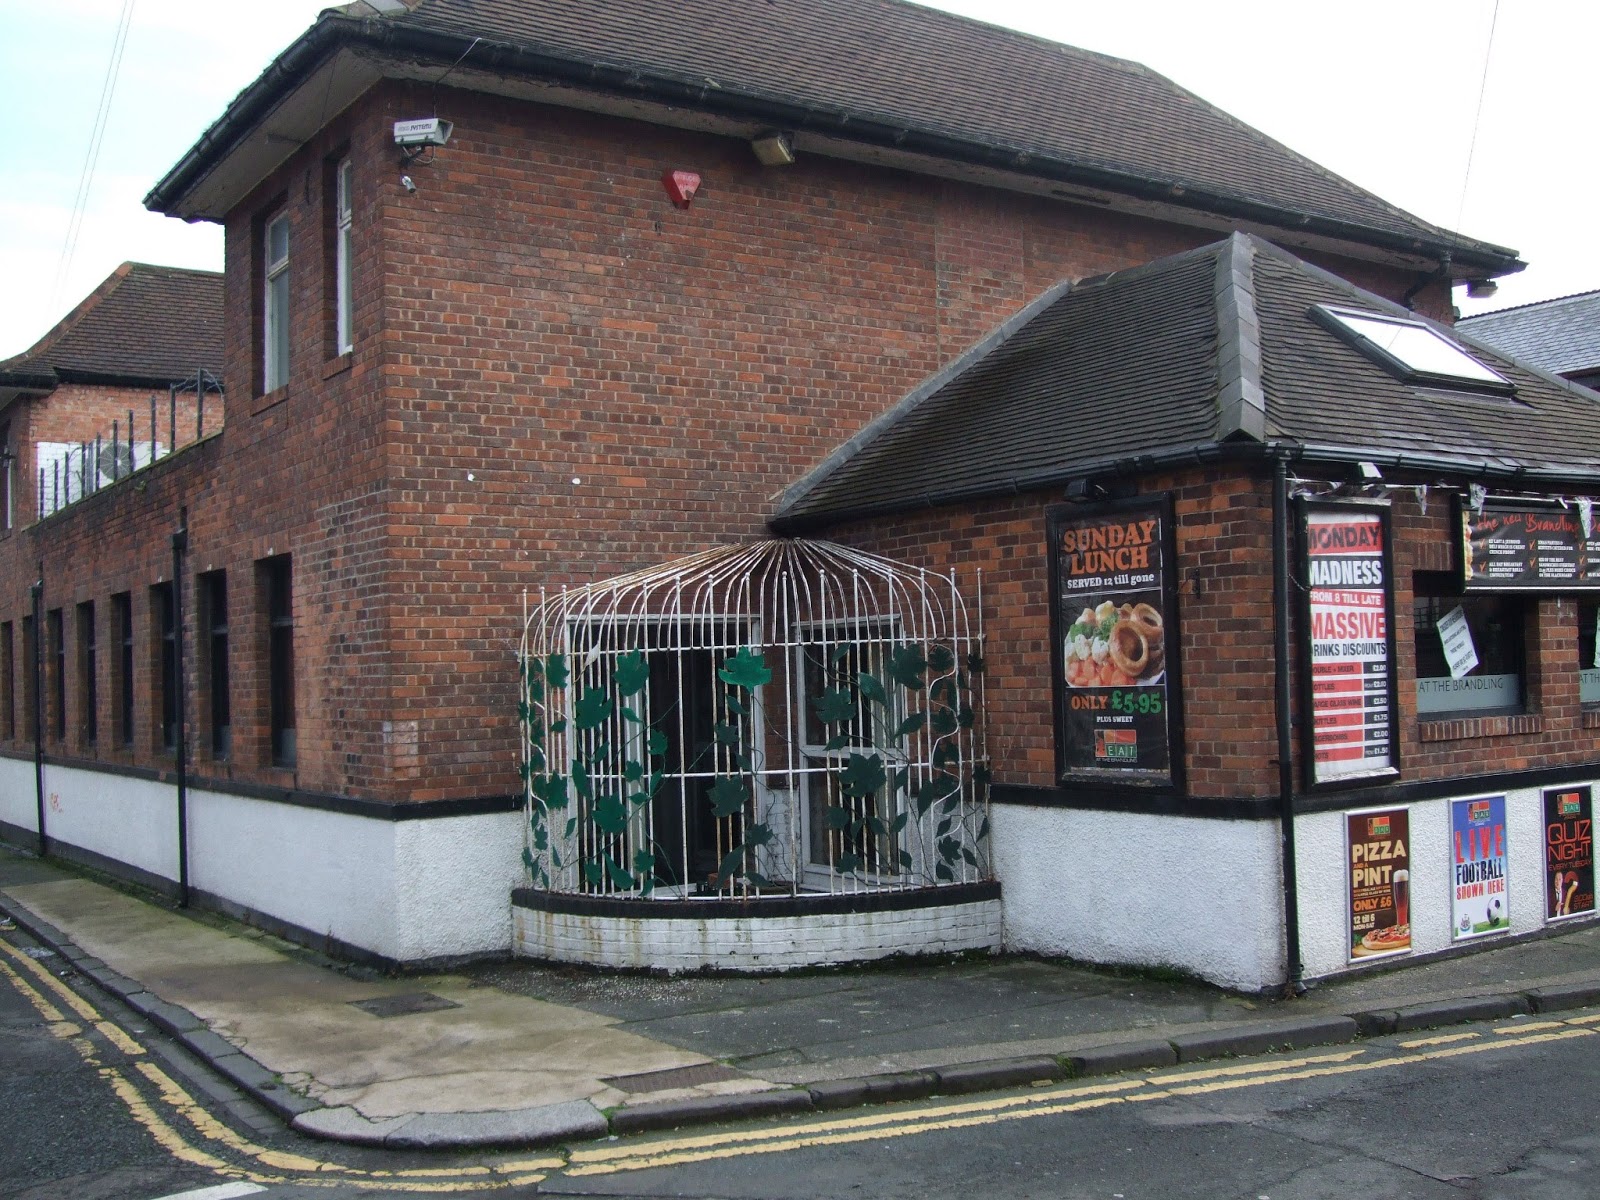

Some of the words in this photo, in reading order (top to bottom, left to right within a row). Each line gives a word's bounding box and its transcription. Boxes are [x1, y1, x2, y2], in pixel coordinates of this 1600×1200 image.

[1063, 520, 1156, 553] SUNDAY
[1308, 525, 1380, 549] MONDAY
[1070, 545, 1149, 575] LUNCH
[1067, 577, 1102, 589] SERVED
[1103, 578, 1113, 587] 12
[1113, 574, 1129, 585] till
[1131, 573, 1155, 586] gone
[1309, 560, 1382, 585] MADNESS
[1335, 593, 1340, 602] 8
[1342, 594, 1359, 604] TILL
[1361, 594, 1381, 605] LATE
[1311, 612, 1386, 639] MASSIVE
[1312, 644, 1340, 657] RINKS
[1343, 642, 1386, 656] DISCOUNTS
[1313, 683, 1335, 691] OTTLES
[1419, 681, 1430, 693] AT
[1432, 680, 1450, 692] THE
[1453, 677, 1503, 691] BRANDLING
[1071, 695, 1108, 710] ONLY
[1111, 690, 1162, 714] £5.95
[1314, 700, 1328, 708] ARGE
[1108, 745, 1134, 756] EAT
[1548, 820, 1591, 845] QUIZ
[1352, 840, 1407, 863] PIZZA
[1455, 824, 1504, 863] LIVE
[1548, 840, 1591, 861] NIGHT
[1456, 858, 1503, 885] FOOTBALL
[1549, 863, 1568, 871] EVERY
[1569, 860, 1592, 868] TUESDAY
[1353, 865, 1392, 888] PINT
[1456, 885, 1483, 900] SHOWN
[1487, 879, 1504, 894] HERE
[1353, 899, 1378, 912] ONLY
[1380, 896, 1392, 908] £6
[1354, 915, 1361, 925] 12
[1371, 913, 1375, 923] 6
